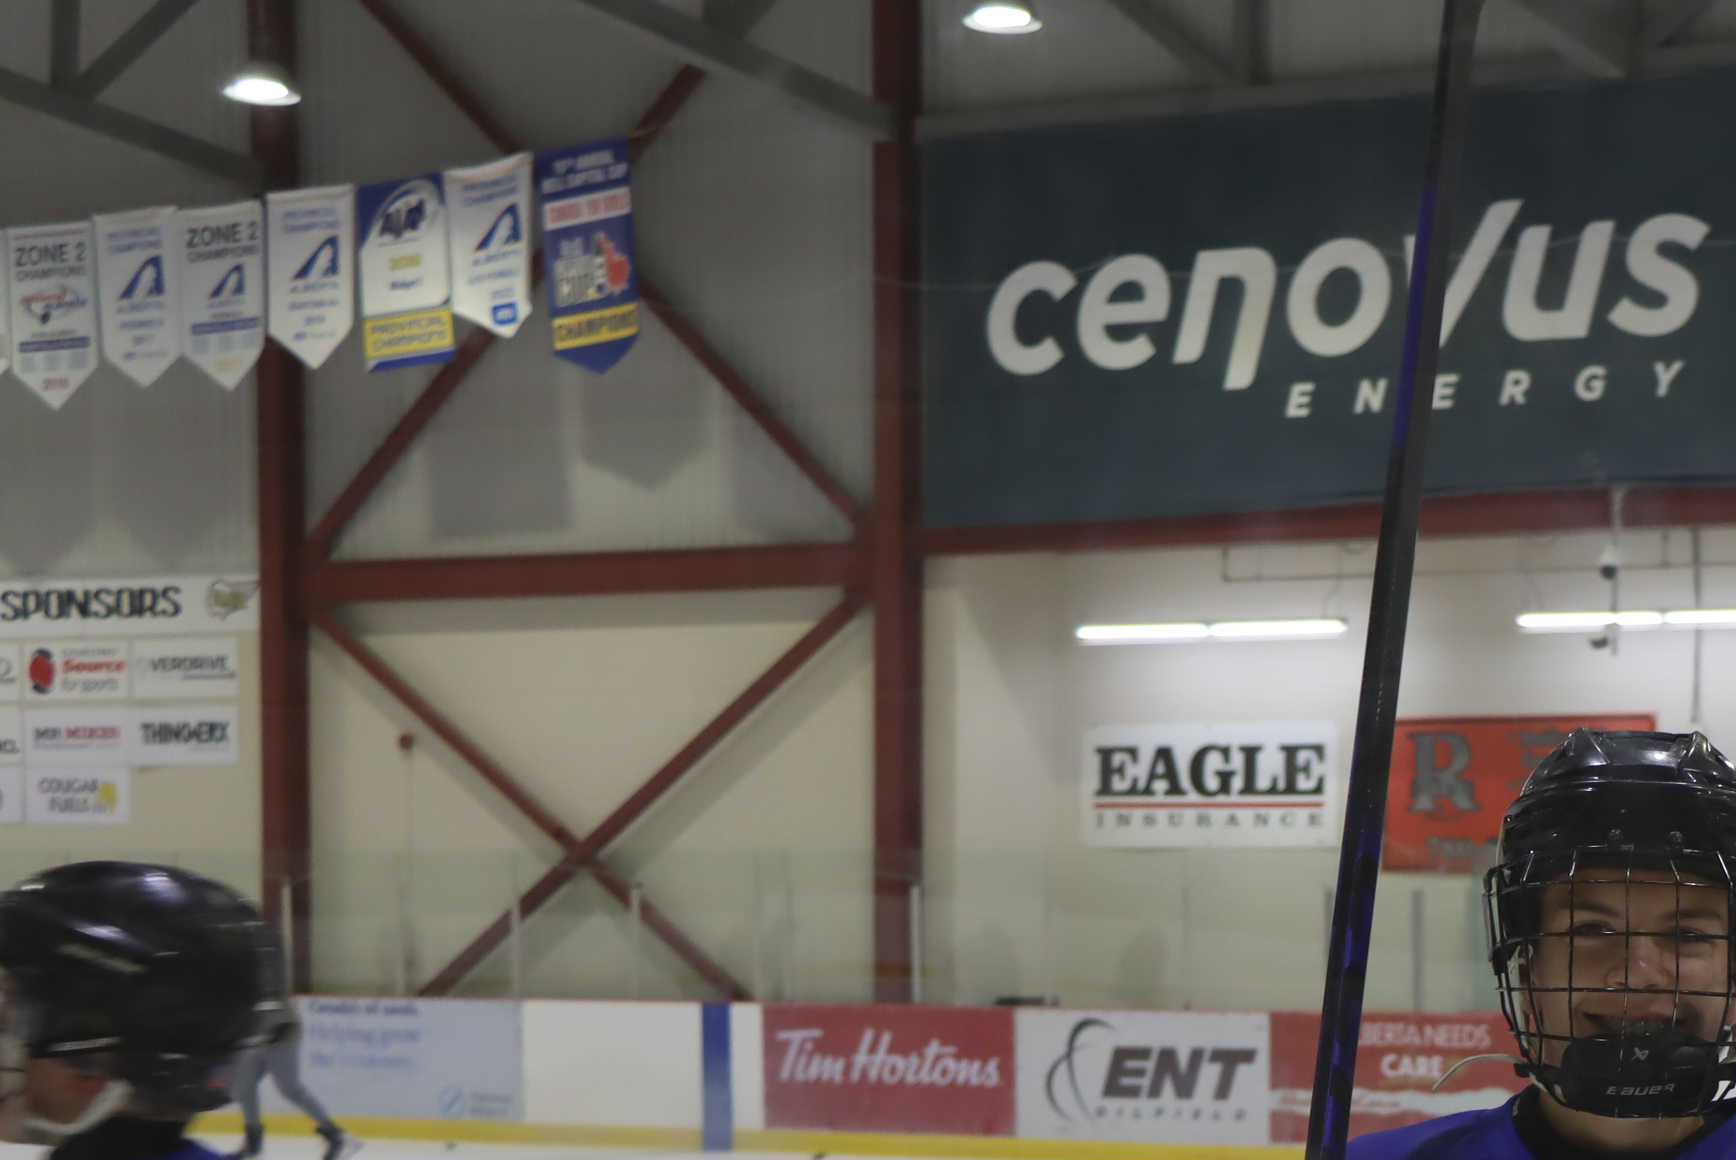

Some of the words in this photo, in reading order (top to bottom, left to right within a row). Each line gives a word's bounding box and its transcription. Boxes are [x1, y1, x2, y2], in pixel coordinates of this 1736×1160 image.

[186, 222, 241, 249] ZONE
[247, 220, 260, 241] 2
[15, 243, 70, 267] ZONE
[75, 241, 87, 262] 2
[1285, 360, 1687, 417] ENERGY
[0, 585, 182, 621] SPONSORS
[1094, 744, 1325, 797] EAGLE
[1096, 811, 1325, 829] INSURANCE
[1359, 1022, 1422, 1047] BERTA
[1423, 1024, 1492, 1050] NEEDS
[776, 1029, 848, 1083] Tim
[851, 1029, 1000, 1089] Hortons
[1102, 1045, 1258, 1100] ENT
[1380, 1053, 1445, 1079] CARE
